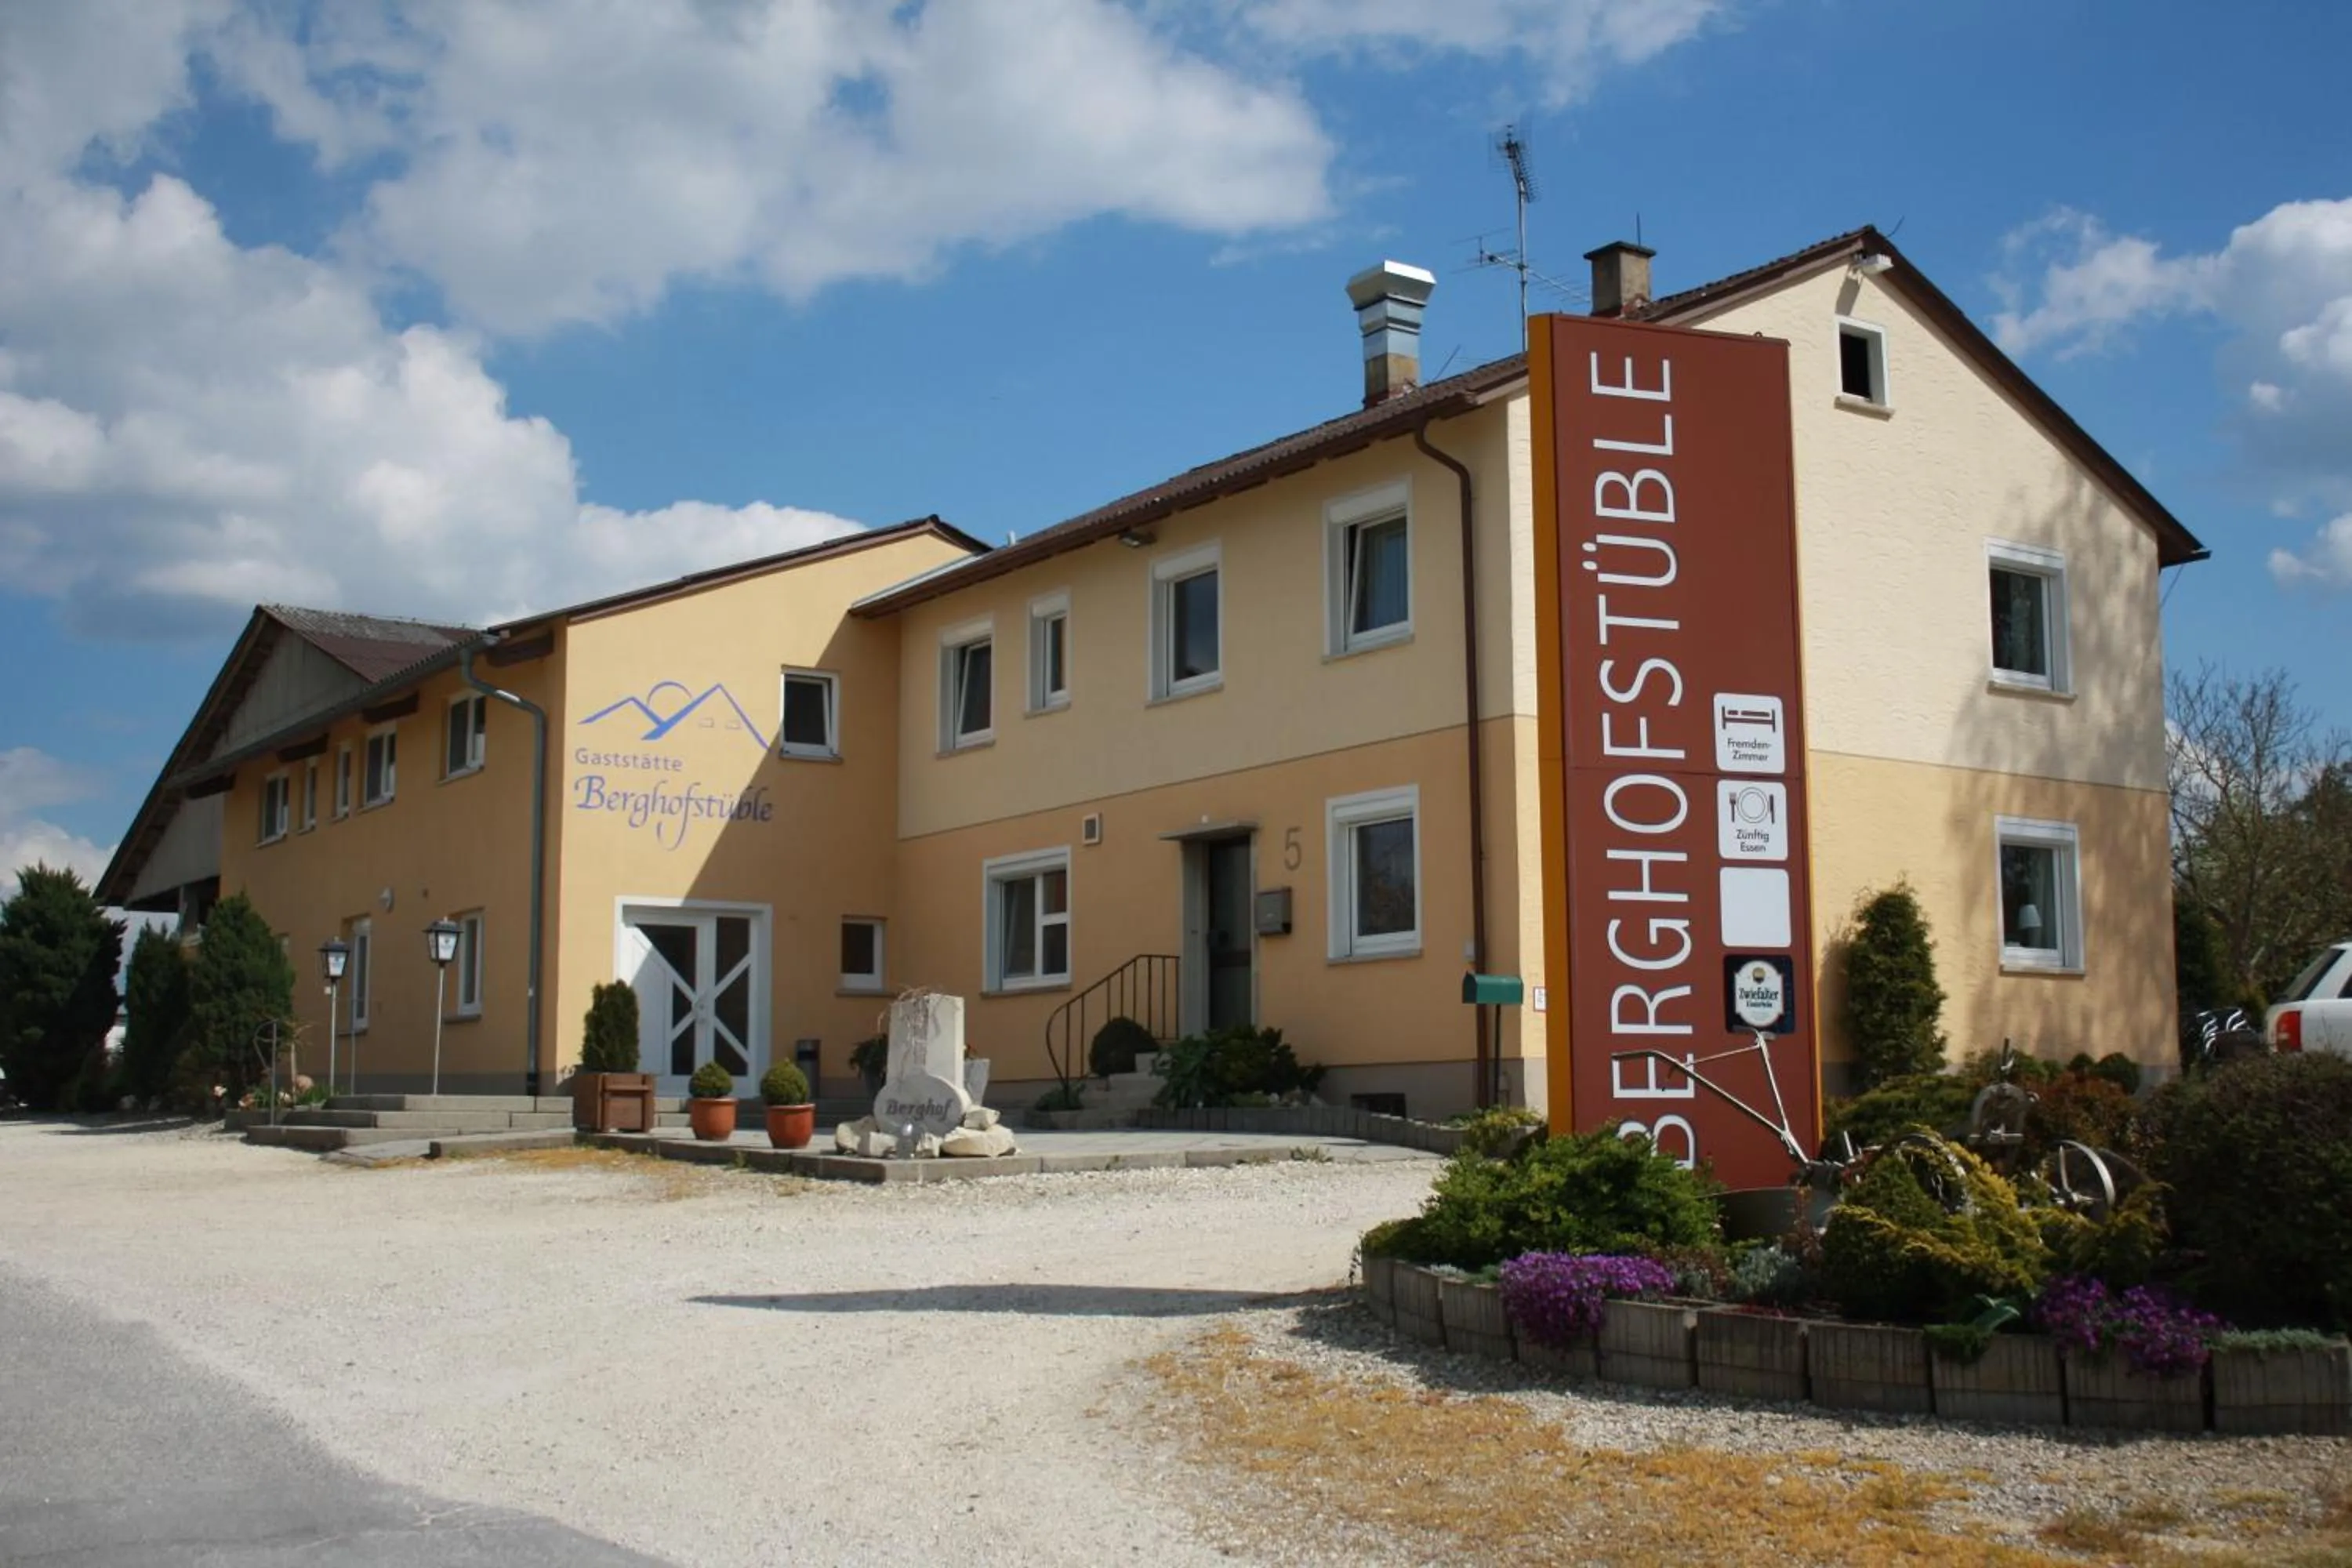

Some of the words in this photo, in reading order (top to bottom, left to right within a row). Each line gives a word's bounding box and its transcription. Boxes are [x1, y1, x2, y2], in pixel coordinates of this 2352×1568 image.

[1726, 737, 1772, 750] Fremden-
[575, 747, 683, 772] Gaststätte
[1581, 350, 1695, 1171] BERGHOFSTÜBLE
[1732, 750, 1769, 761] Zimmer
[573, 775, 773, 851] Berghofstüble
[1736, 829, 1769, 843] Zünftig
[1284, 826, 1302, 872] 5
[1740, 843, 1766, 853] Essen
[885, 1098, 953, 1121] Berghof
